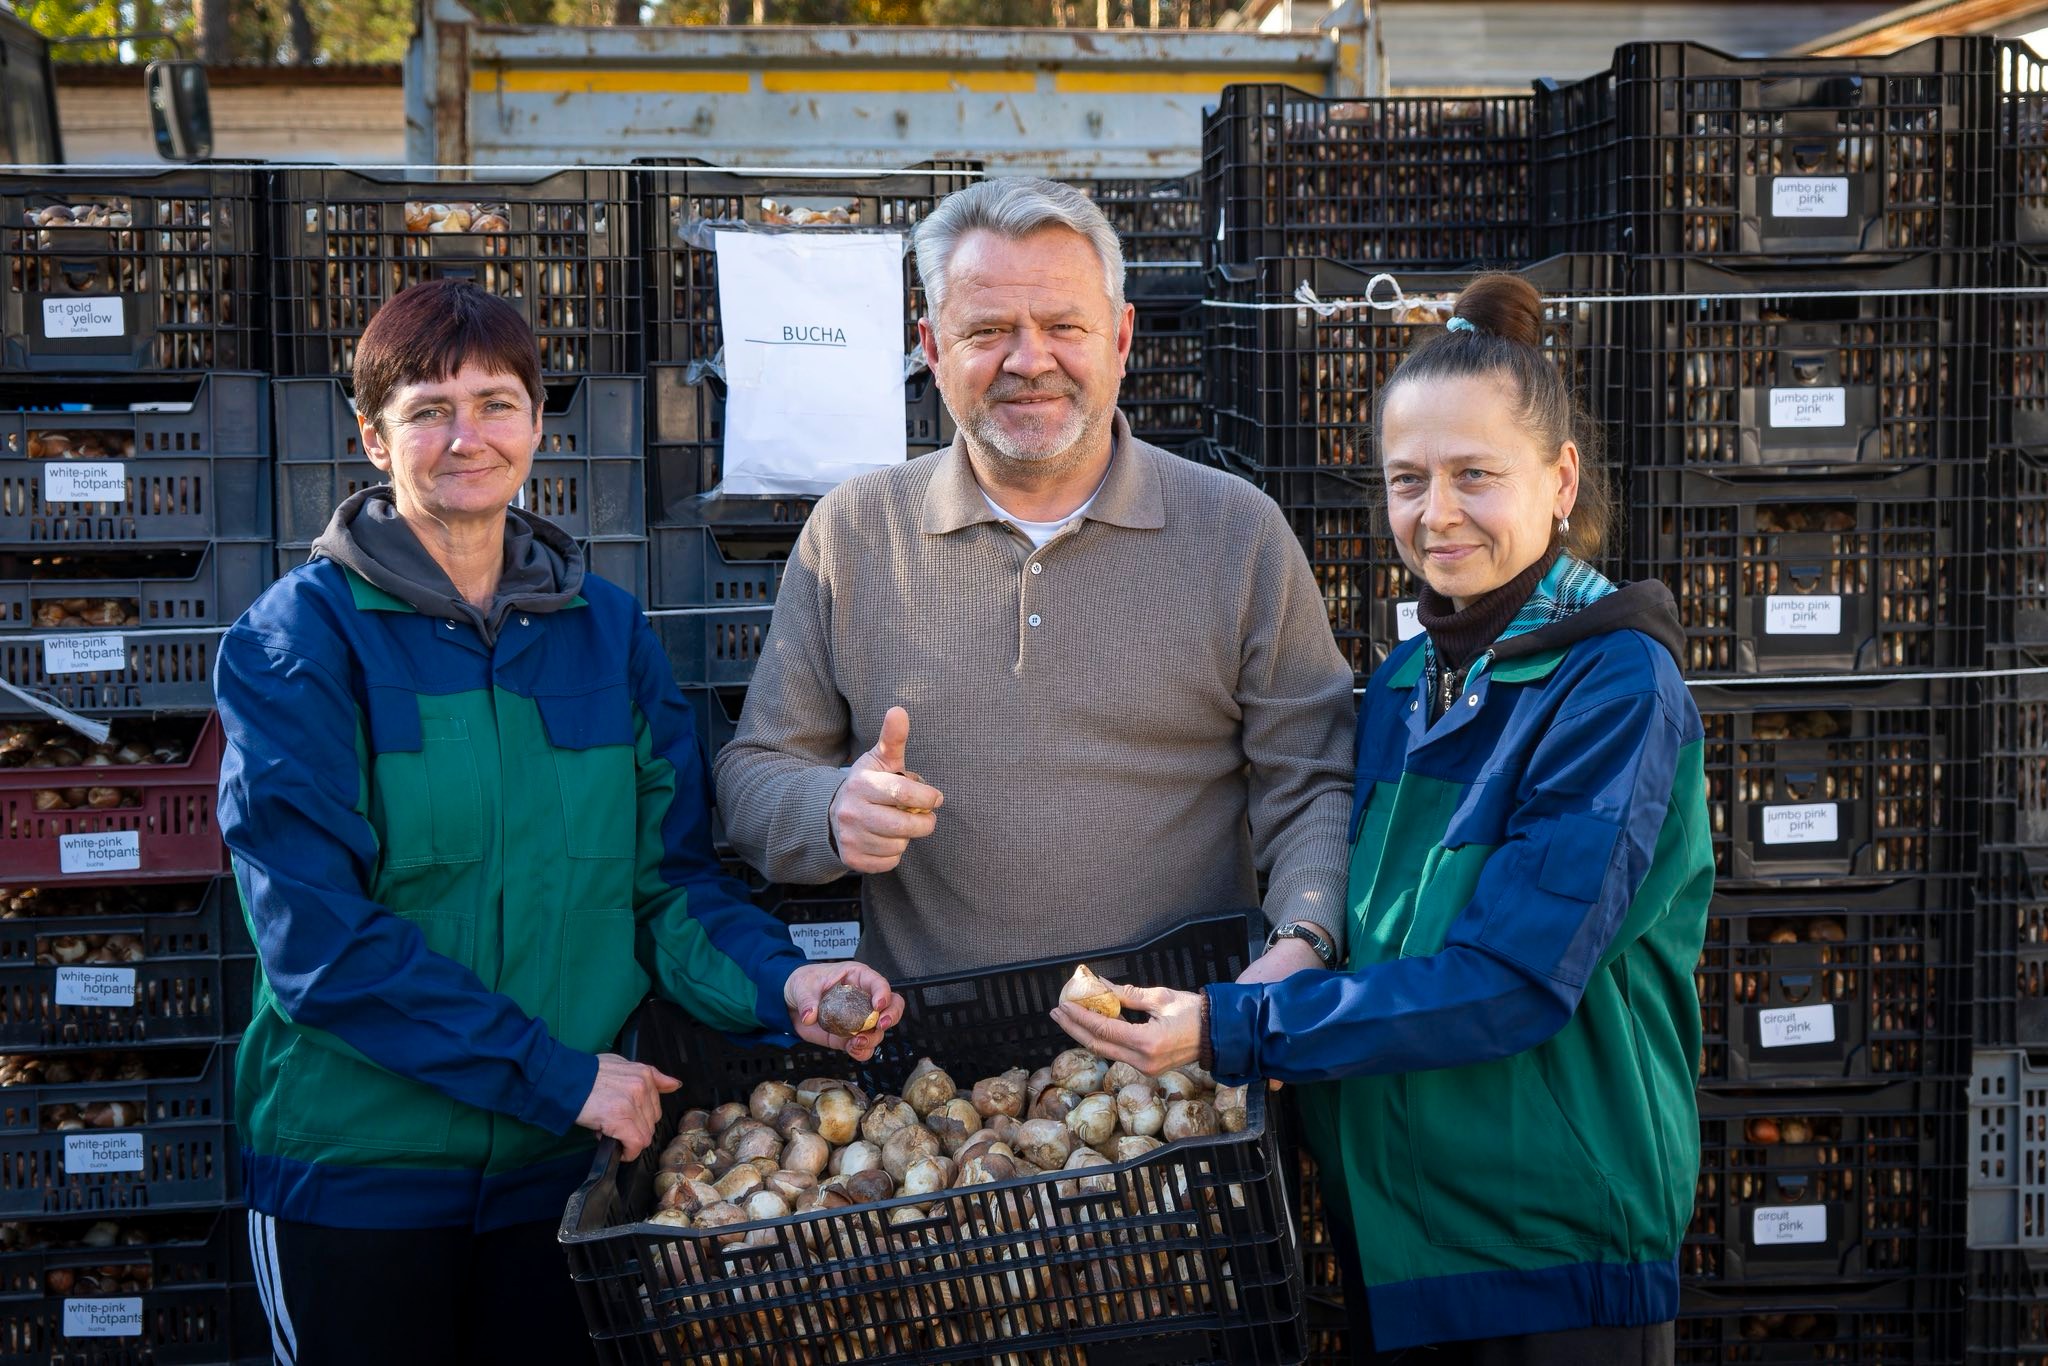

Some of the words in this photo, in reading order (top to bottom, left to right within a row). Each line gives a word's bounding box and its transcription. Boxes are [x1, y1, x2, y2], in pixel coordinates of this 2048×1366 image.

[1777, 182, 1811, 195] jumbo
[1814, 182, 1838, 194] pink
[1799, 194, 1825, 206] pink
[48, 304, 62, 313] srt
[66, 302, 92, 316] gold
[72, 313, 112, 327] yellow
[783, 326, 846, 343] BUCHA
[1775, 392, 1808, 405] jumbo
[1812, 392, 1834, 403] pink
[1796, 404, 1822, 416] pink
[50, 467, 107, 479] white-pink
[73, 478, 127, 491] hotpants
[1402, 607, 1418, 617] dy
[1771, 600, 1805, 612] jumbo
[1808, 600, 1830, 611] pink
[1792, 611, 1817, 623] pink
[48, 638, 107, 649] white-pink
[1768, 810, 1801, 823] jumbo
[1804, 808, 1826, 820] pink
[1790, 820, 1814, 832] pink
[64, 836, 122, 849] white-pink
[792, 927, 845, 938] white-pink
[60, 972, 119, 984] white-pink
[1764, 1013, 1796, 1024] circuit
[1786, 1021, 1812, 1035] pink
[69, 1138, 126, 1150] white-pink
[1758, 1211, 1790, 1221] circuit
[1778, 1220, 1804, 1232] pink
[68, 1302, 126, 1314] white-pink
